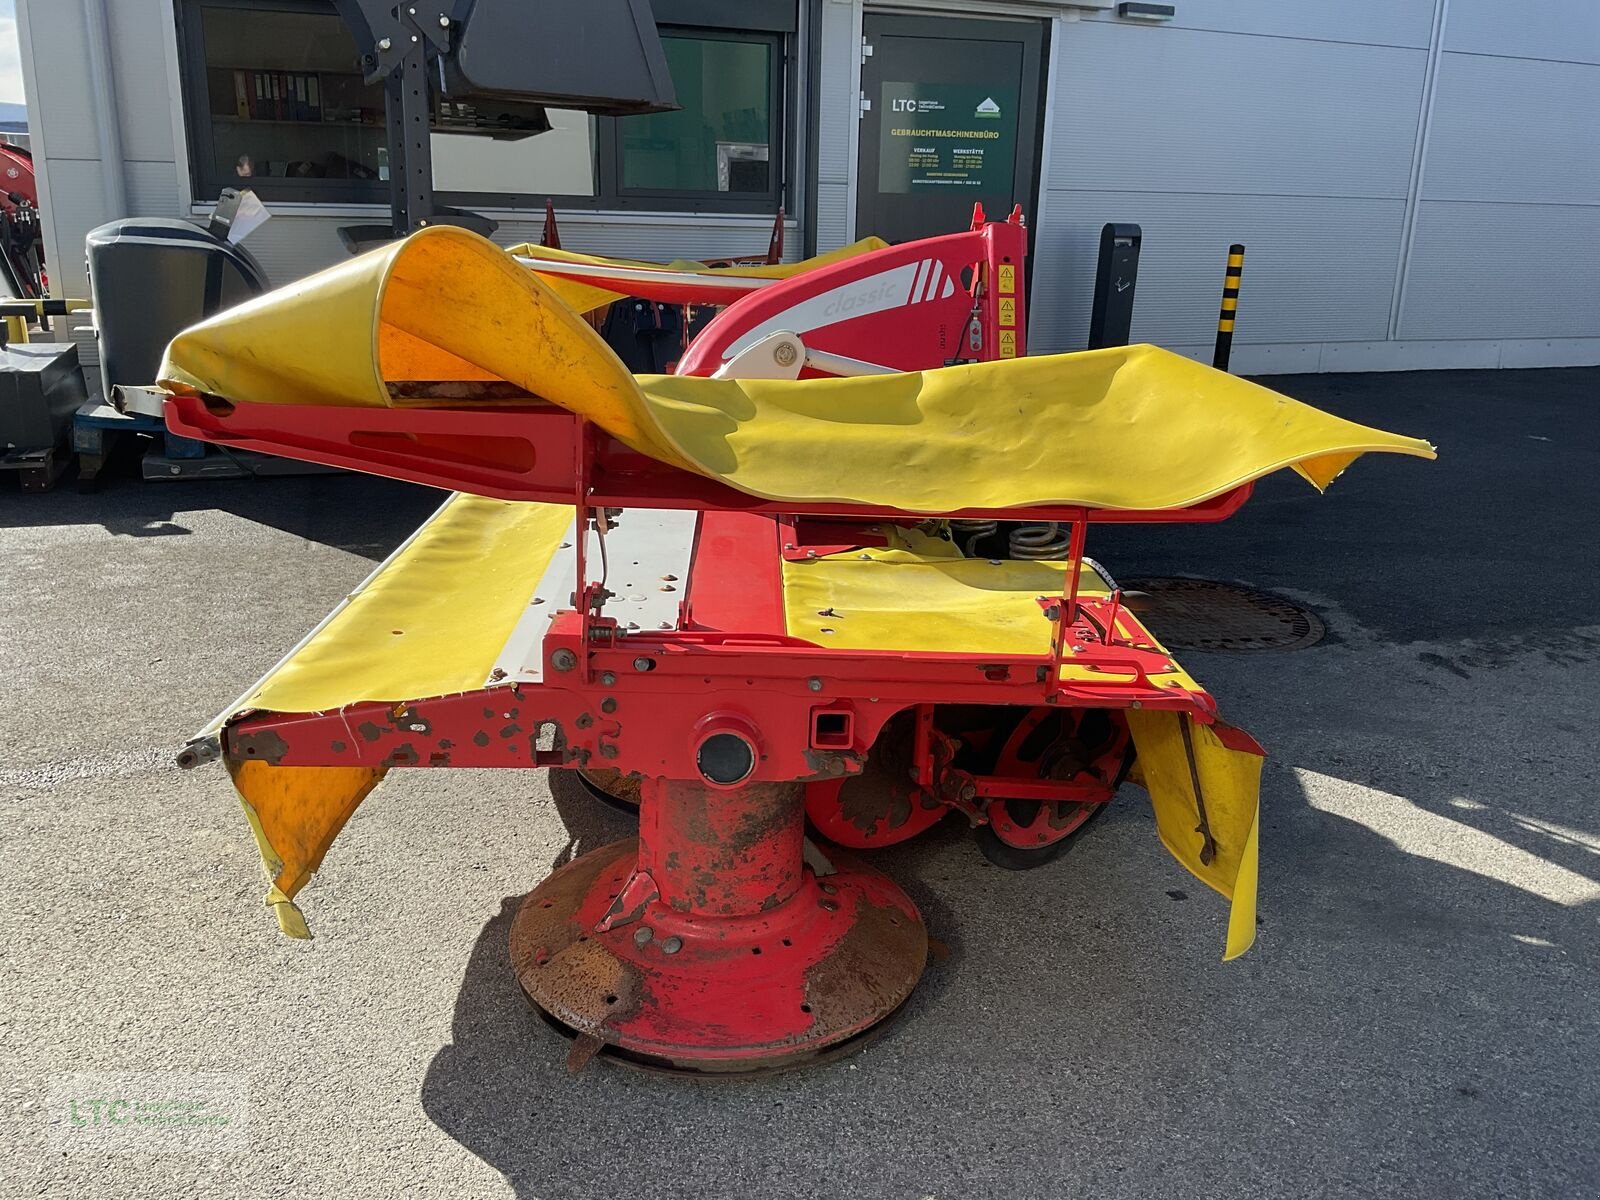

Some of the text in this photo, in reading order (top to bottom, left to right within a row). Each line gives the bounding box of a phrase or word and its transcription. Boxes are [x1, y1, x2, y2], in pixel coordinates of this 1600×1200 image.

[892, 99, 916, 112] LTC
[891, 128, 999, 139] GEBRAUCHTMASCHINENBÜRO
[823, 282, 896, 317] classic
